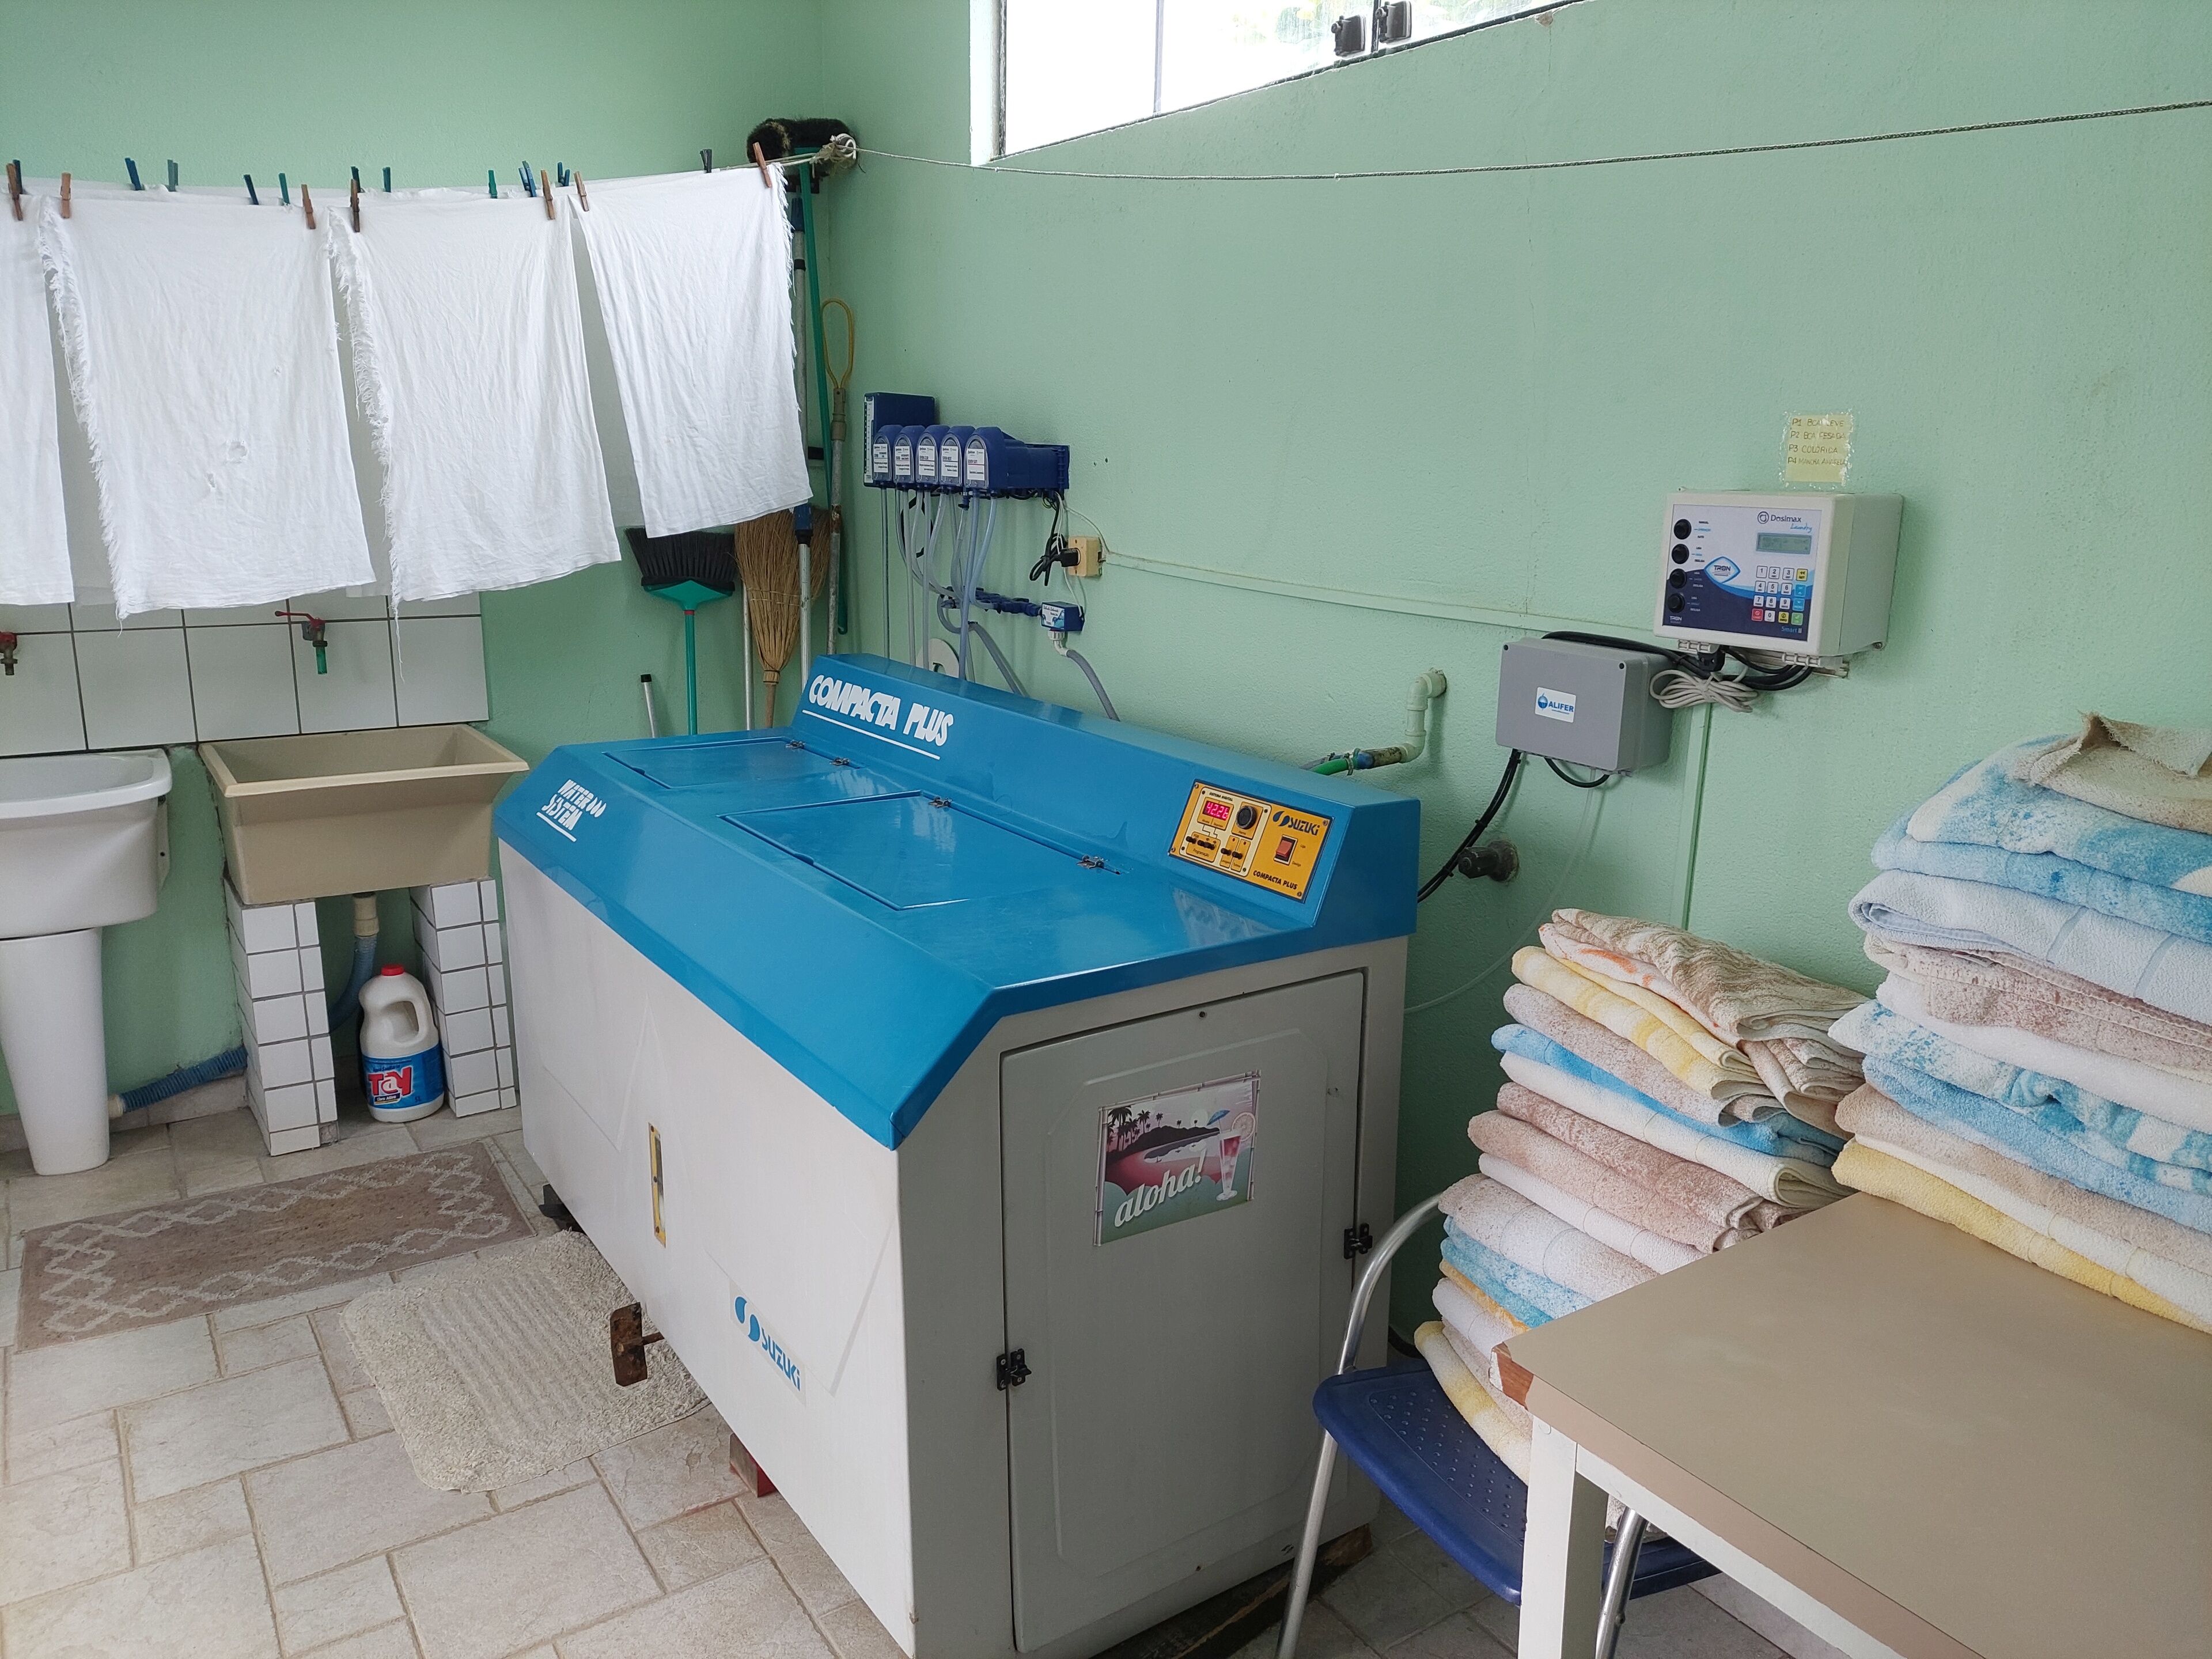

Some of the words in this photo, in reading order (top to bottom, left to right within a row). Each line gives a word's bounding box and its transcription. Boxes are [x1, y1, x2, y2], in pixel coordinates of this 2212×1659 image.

[1792, 418, 1801, 426] P1
[1791, 430, 1800, 438] P2
[1804, 431, 1816, 440] BCA
[1789, 444, 1798, 452] P3
[1801, 445, 1838, 453] COLORIDA
[1771, 514, 1802, 522] Dosimax
[809, 675, 901, 730] COMPACTA
[903, 703, 953, 747] PLUS
[1548, 701, 1574, 712] ALIFER
[558, 779, 594, 809] WATER
[1253, 870, 1282, 885] COMPACTA
[1283, 880, 1298, 890] PLUS
[1114, 1147, 1207, 1228] aloha!
